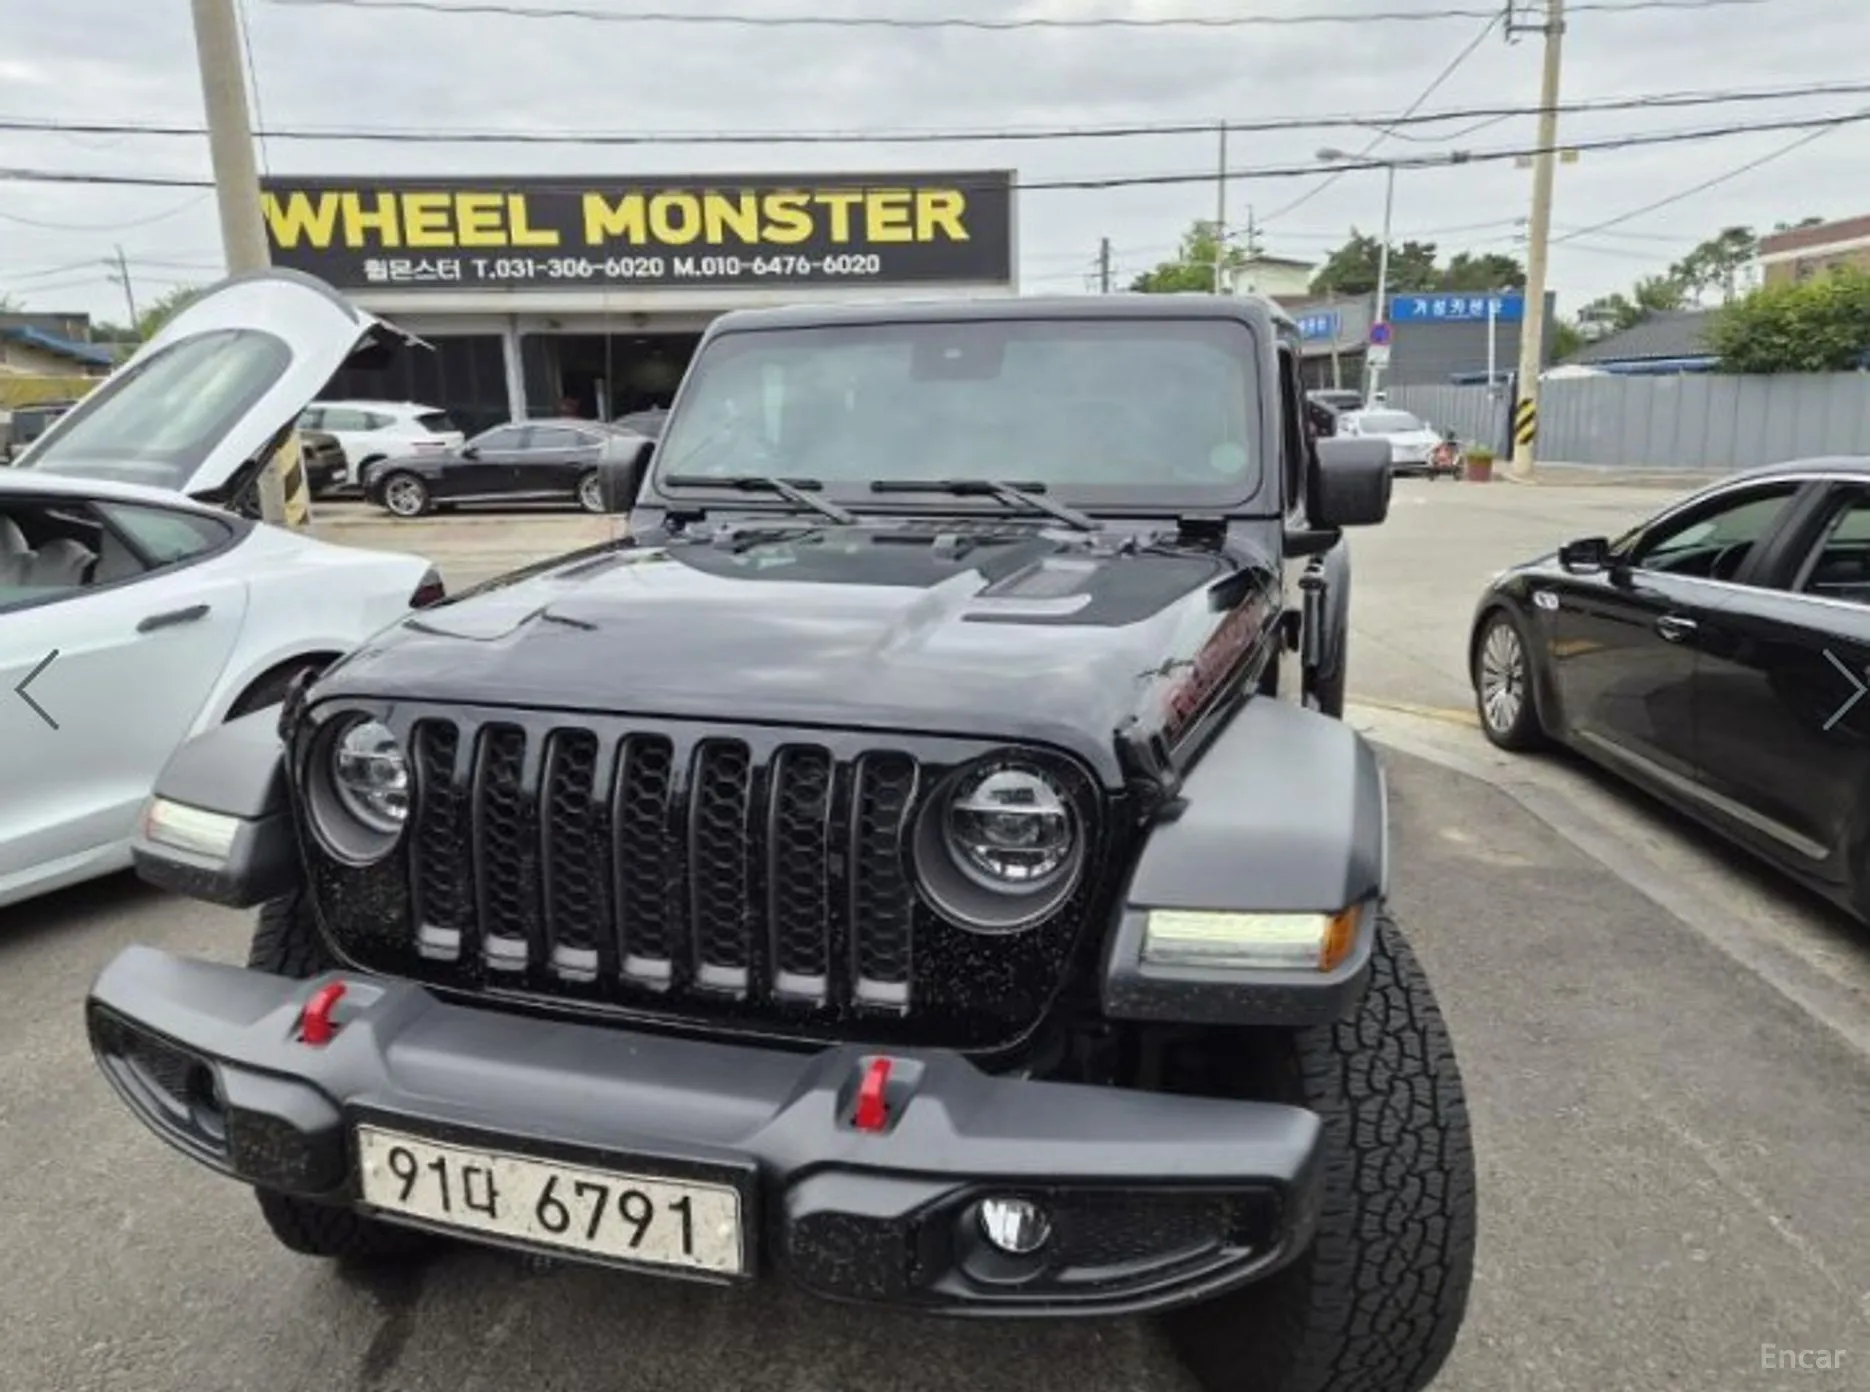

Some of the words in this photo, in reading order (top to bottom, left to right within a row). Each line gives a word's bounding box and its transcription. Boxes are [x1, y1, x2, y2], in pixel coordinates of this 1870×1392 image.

[263, 190, 560, 248] WHEEL
[583, 187, 970, 246] MONSTER
[472, 256, 664, 279] T.031-306-6020
[674, 253, 880, 277] M.010-6476-6020
[388, 1146, 500, 1220] 91다
[536, 1174, 693, 1255] 6791
